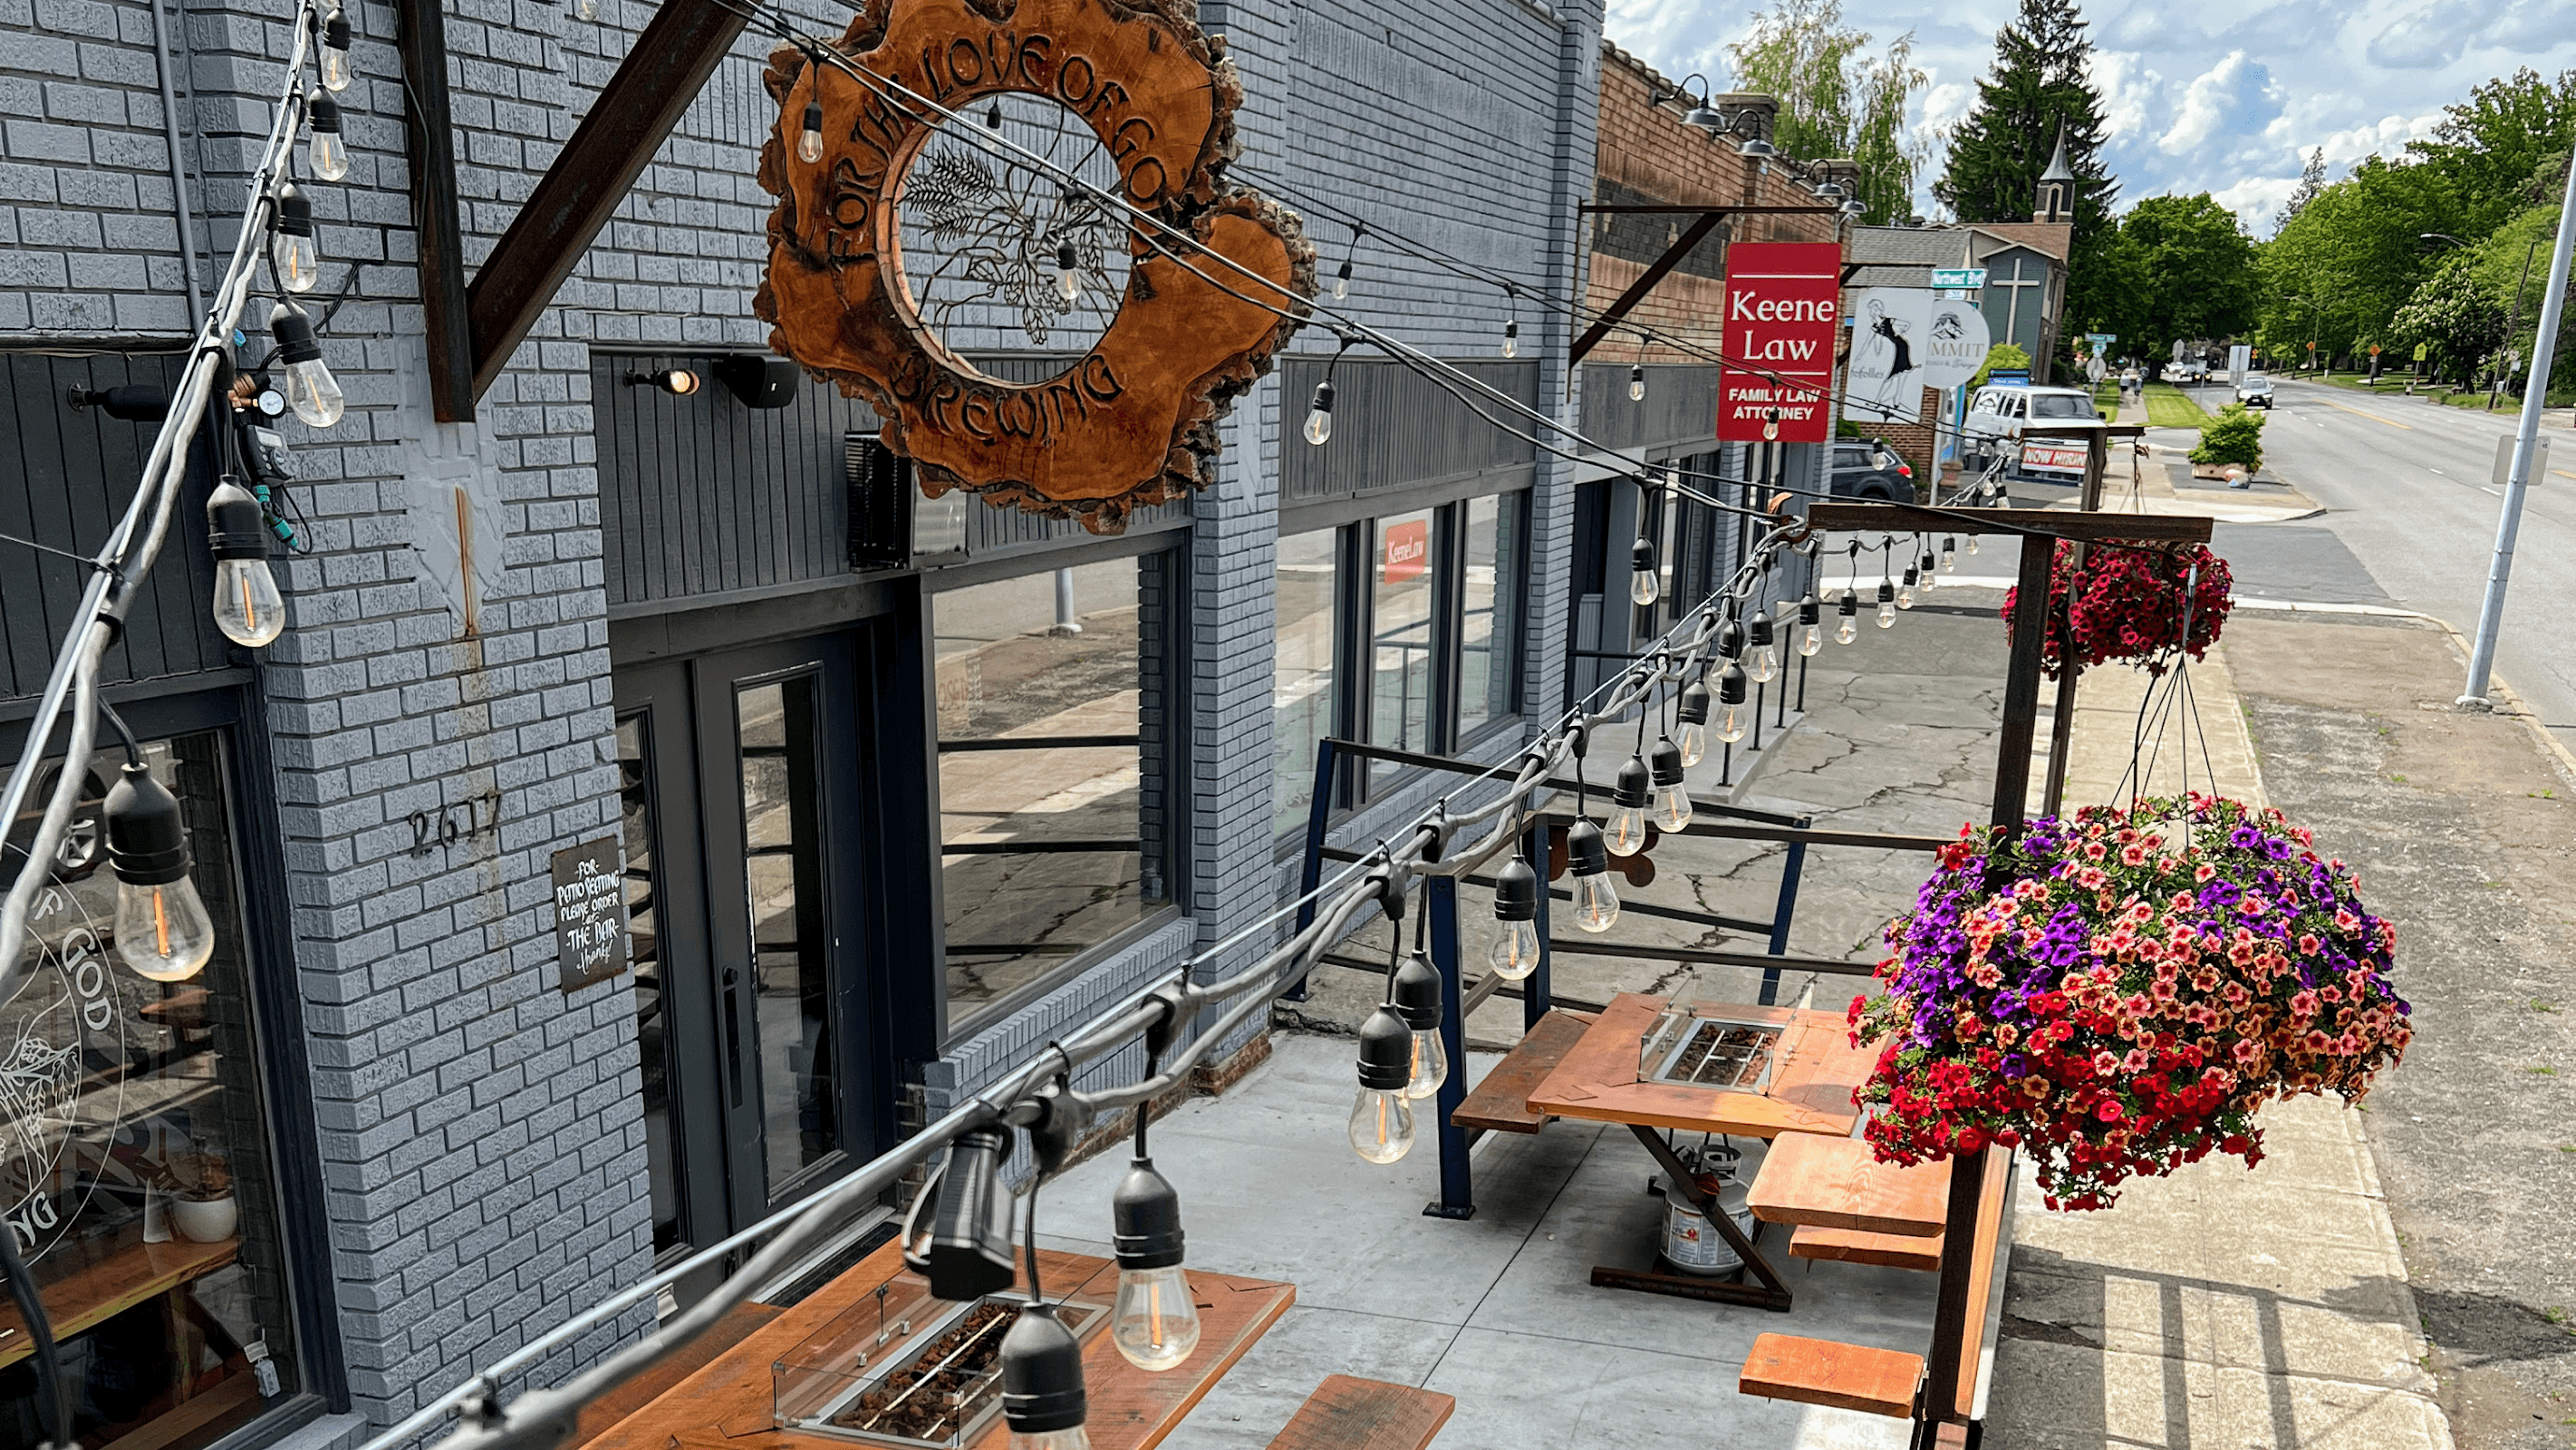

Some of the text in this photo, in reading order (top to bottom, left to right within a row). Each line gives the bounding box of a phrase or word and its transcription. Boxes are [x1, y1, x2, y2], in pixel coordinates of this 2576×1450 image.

[921, 33, 1051, 102] LOVE
[1059, 54, 1132, 116] OF
[1731, 291, 1835, 322] Keene
[1743, 329, 1817, 361] Law
[1930, 342, 1985, 357] MMIT
[891, 349, 1125, 440] BREWING
[1729, 388, 1820, 403] FAMILY LAW
[2023, 448, 2086, 468] NOW HIRIN
[410, 792, 502, 858] 2617
[556, 870, 620, 906] PATIO SEATING
[561, 892, 619, 923] PLEASE ORDER
[62, 927, 111, 1031] GOD
